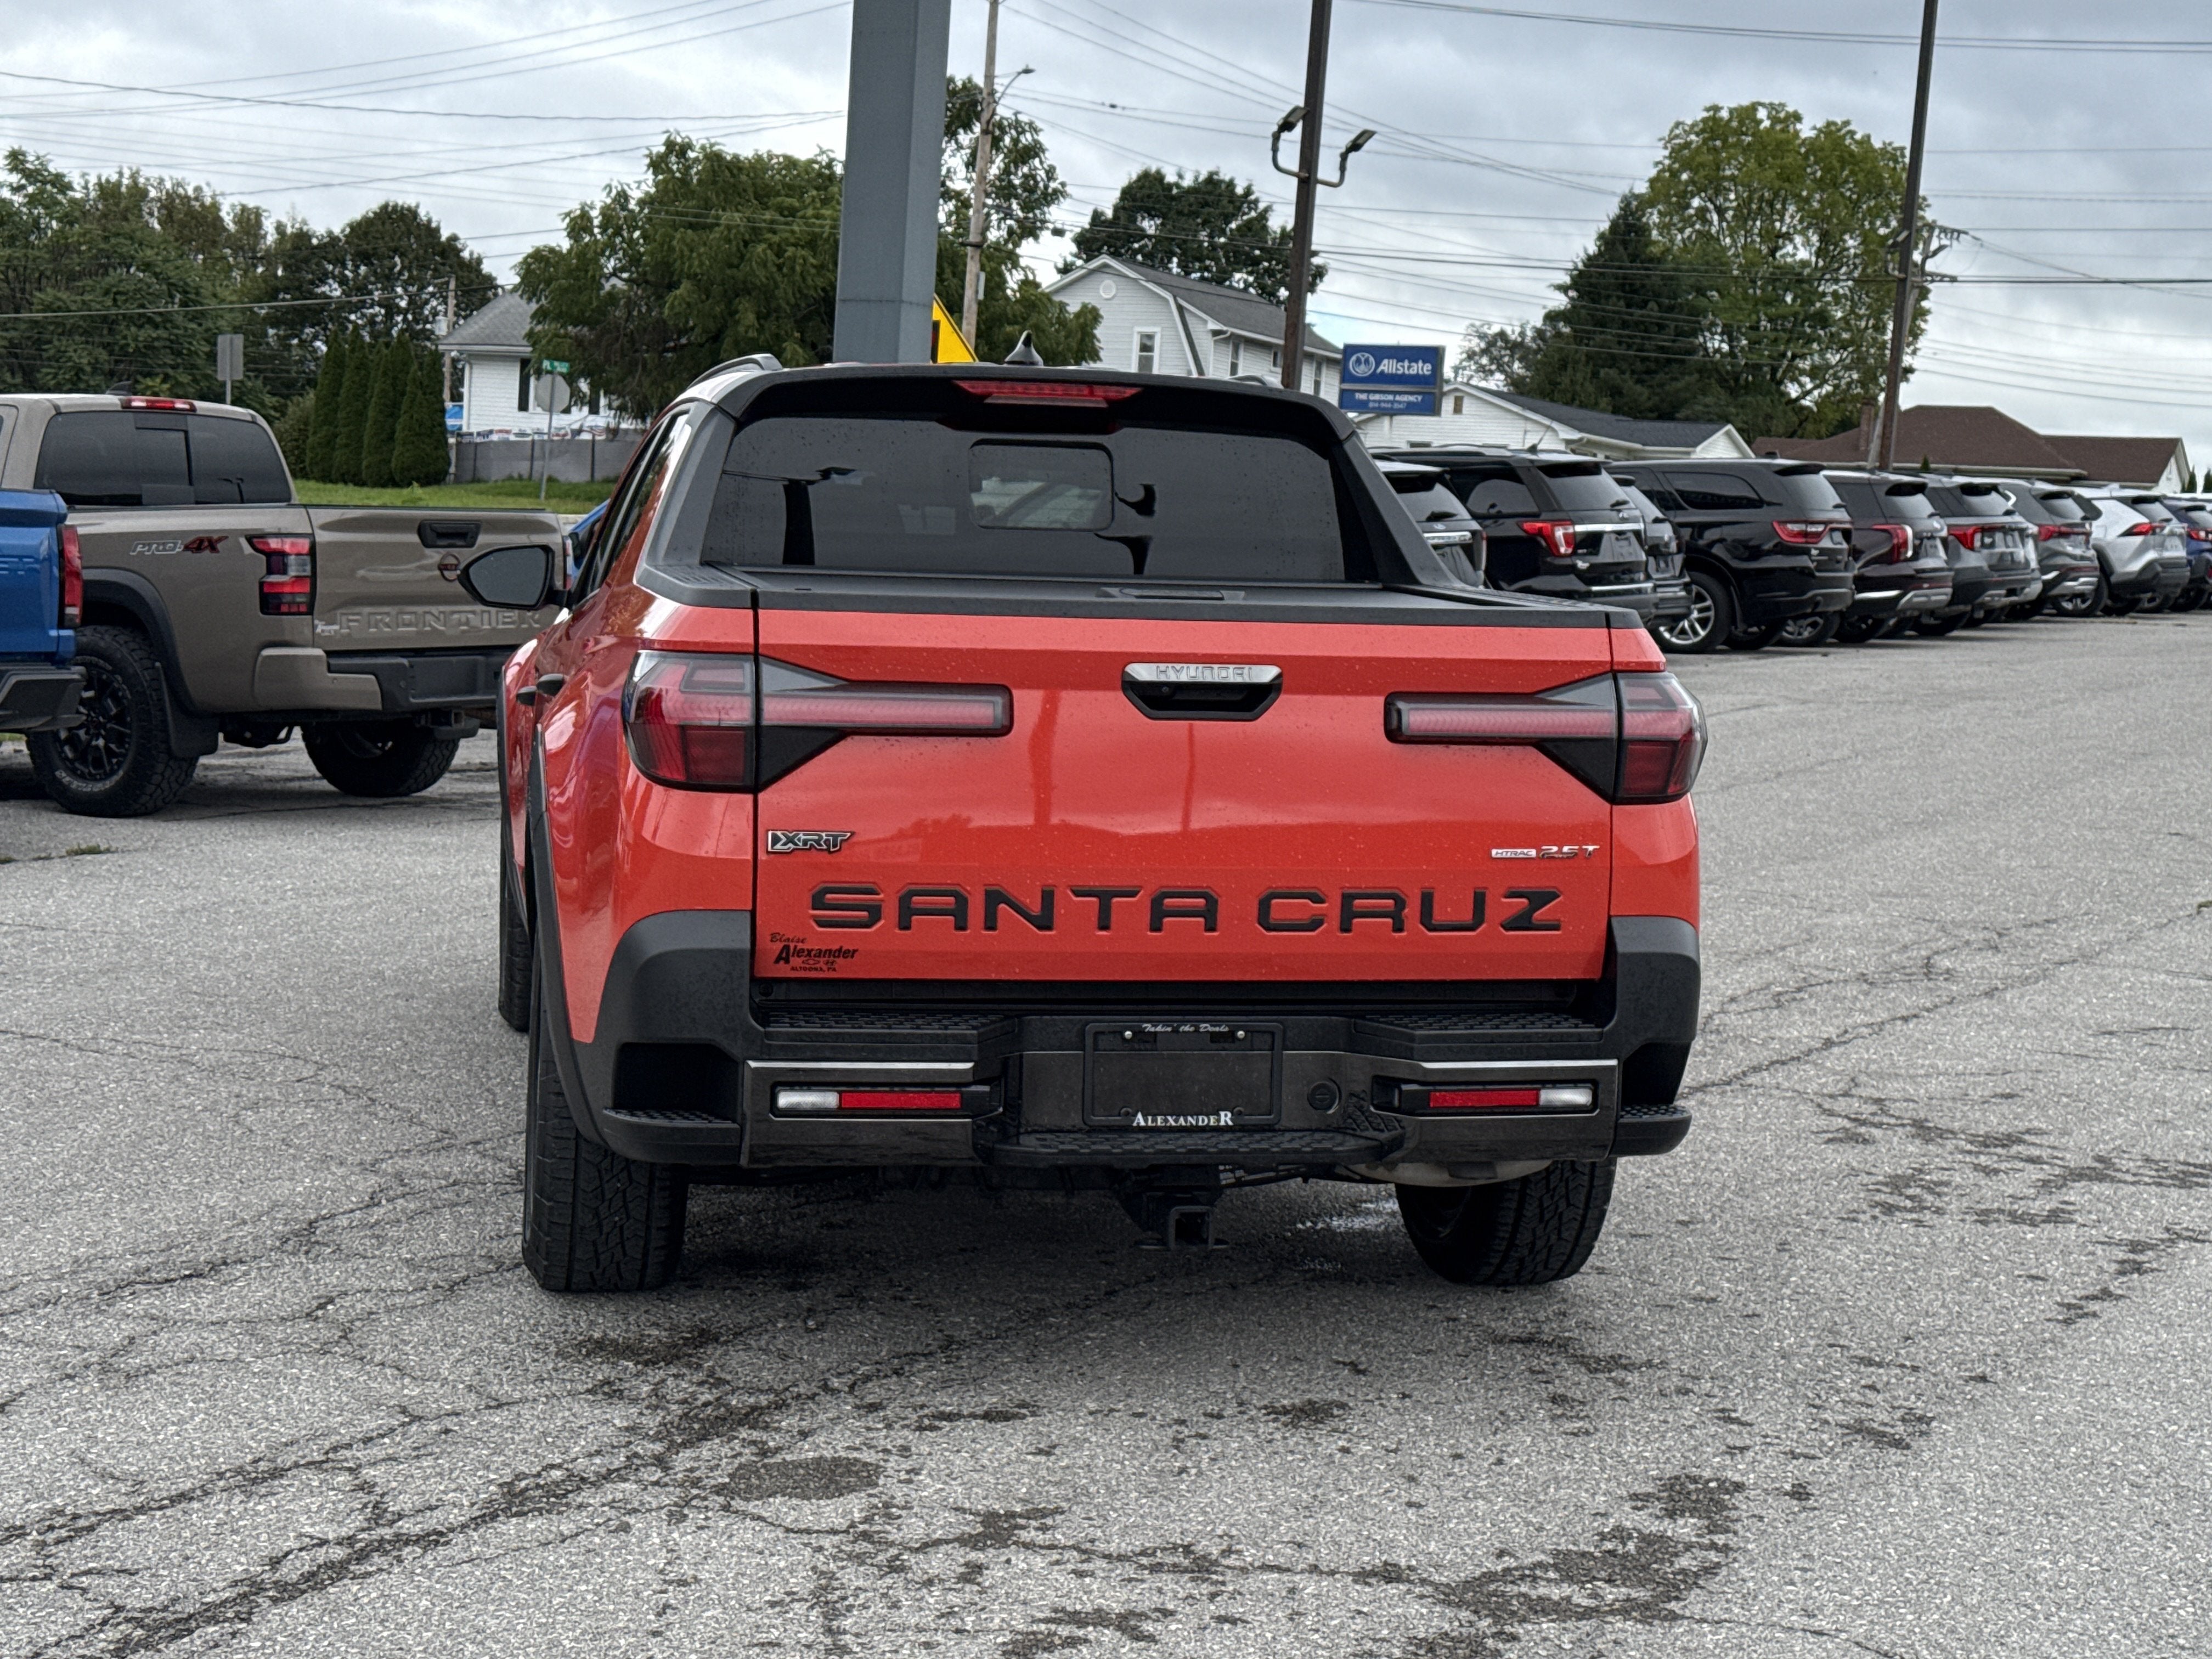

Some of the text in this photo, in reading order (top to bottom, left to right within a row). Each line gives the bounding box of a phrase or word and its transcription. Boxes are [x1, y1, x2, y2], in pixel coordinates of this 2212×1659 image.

[1376, 358, 1431, 375] Allstate
[1395, 394, 1423, 402] AGENCY
[337, 610, 541, 633] FRONTIER
[1155, 665, 1254, 681] HYUNDAI
[769, 831, 853, 851] XRT
[811, 884, 1562, 933] SANTA CRUZ
[769, 933, 808, 943] Blaise
[774, 944, 859, 964] Alexander
[1180, 1024, 1195, 1032] the
[1132, 1111, 1234, 1126] ALEXANDER
